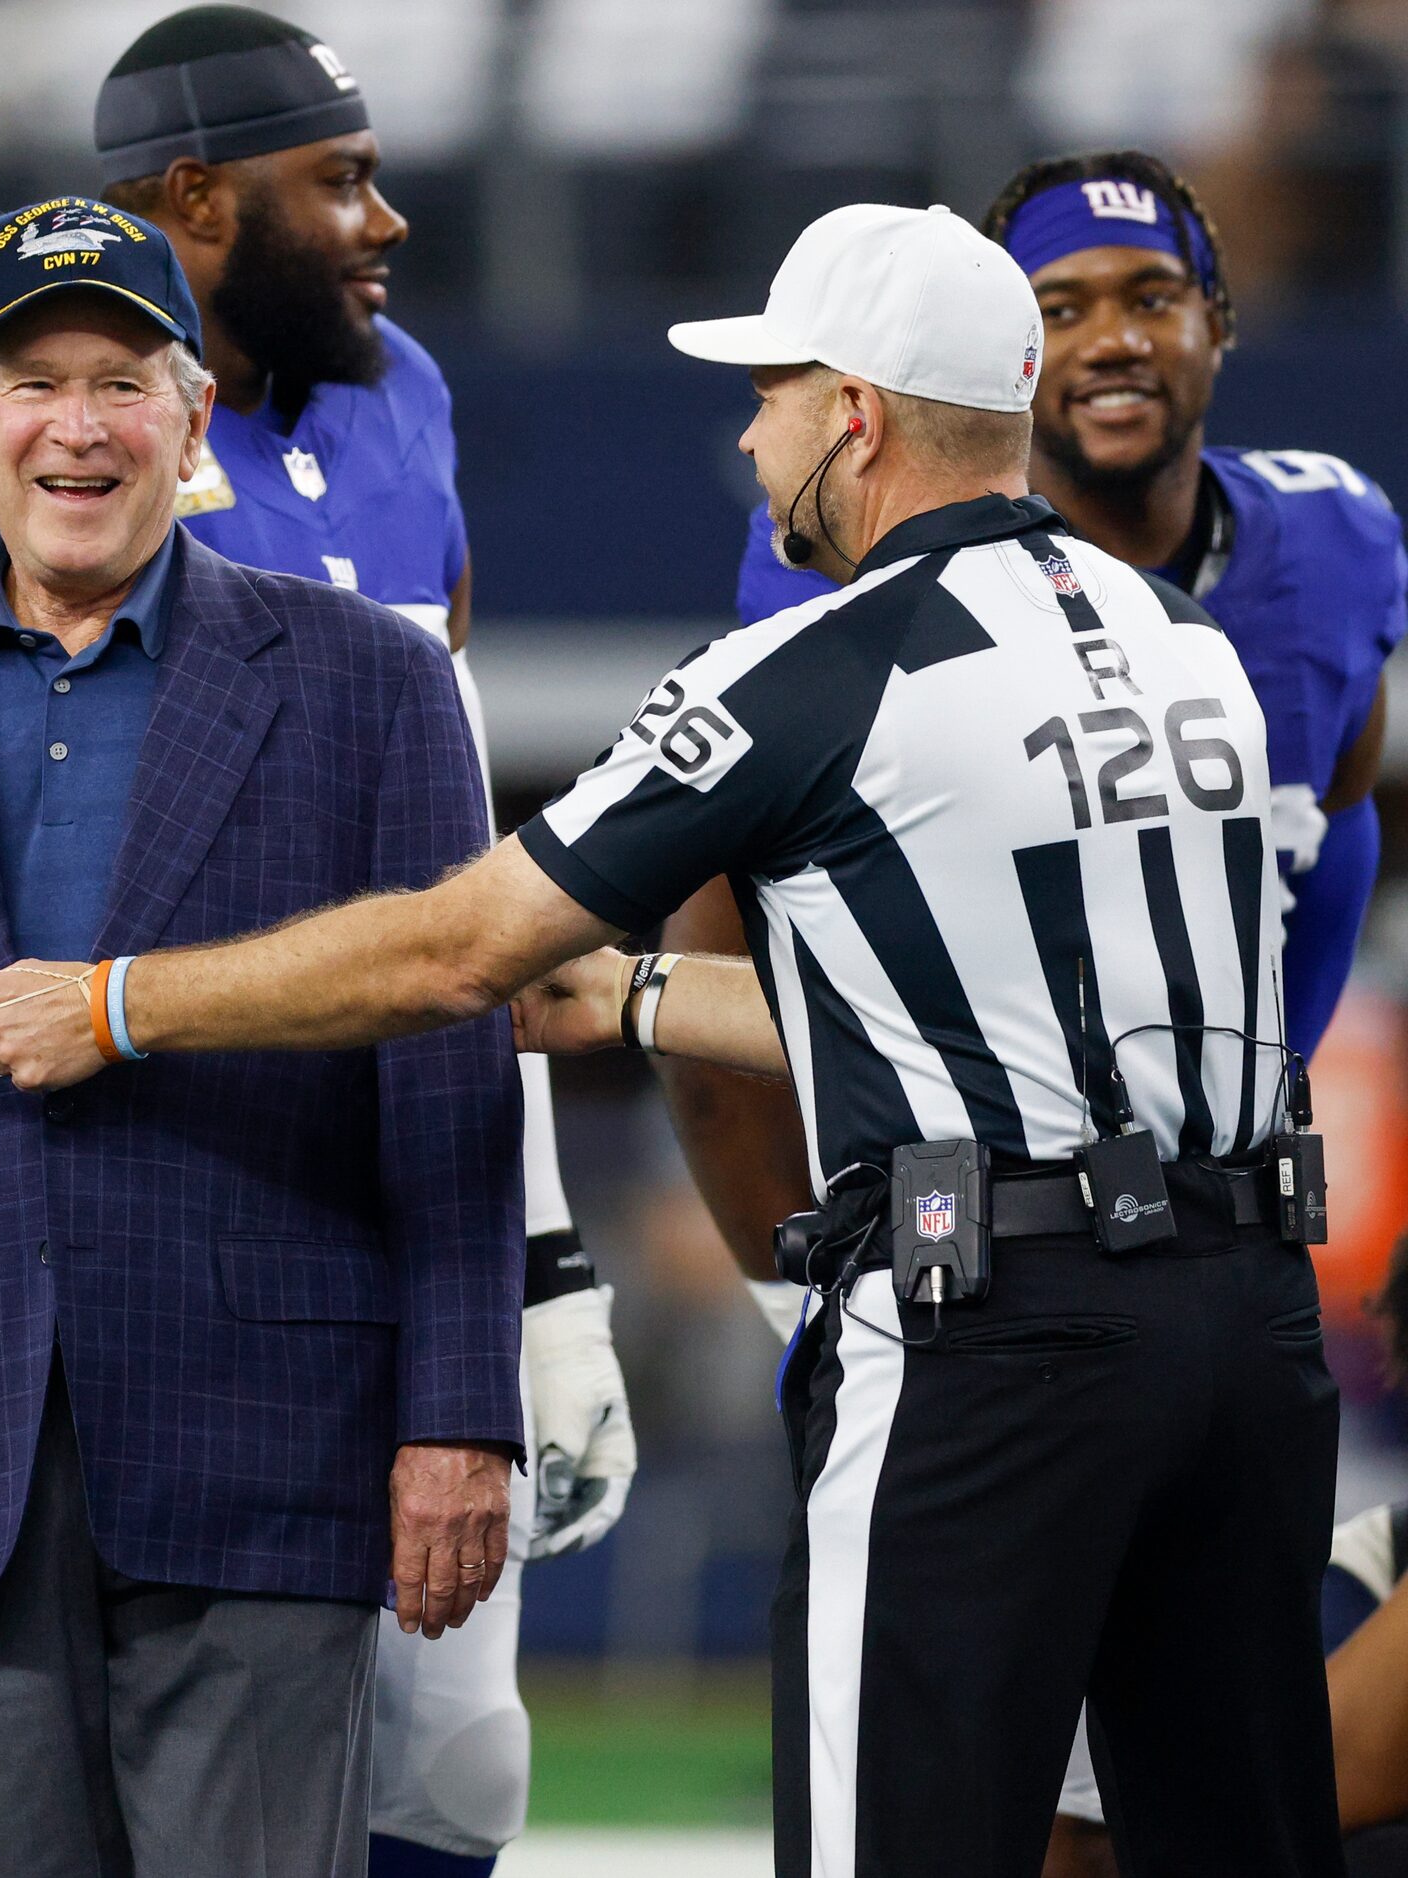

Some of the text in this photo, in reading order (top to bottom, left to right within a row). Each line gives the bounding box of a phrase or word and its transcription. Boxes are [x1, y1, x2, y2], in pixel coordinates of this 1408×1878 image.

[15, 198, 70, 226] GEORGE
[92, 203, 109, 216] W.
[109, 213, 147, 243] BUSH
[44, 252, 100, 270] CVN 77
[1049, 573, 1078, 592] NFL
[1072, 638, 1144, 700] R
[630, 679, 734, 774] 26
[1023, 697, 1244, 830] 126
[1282, 1171, 1292, 1193] REF
[922, 1212, 950, 1233] NFL
